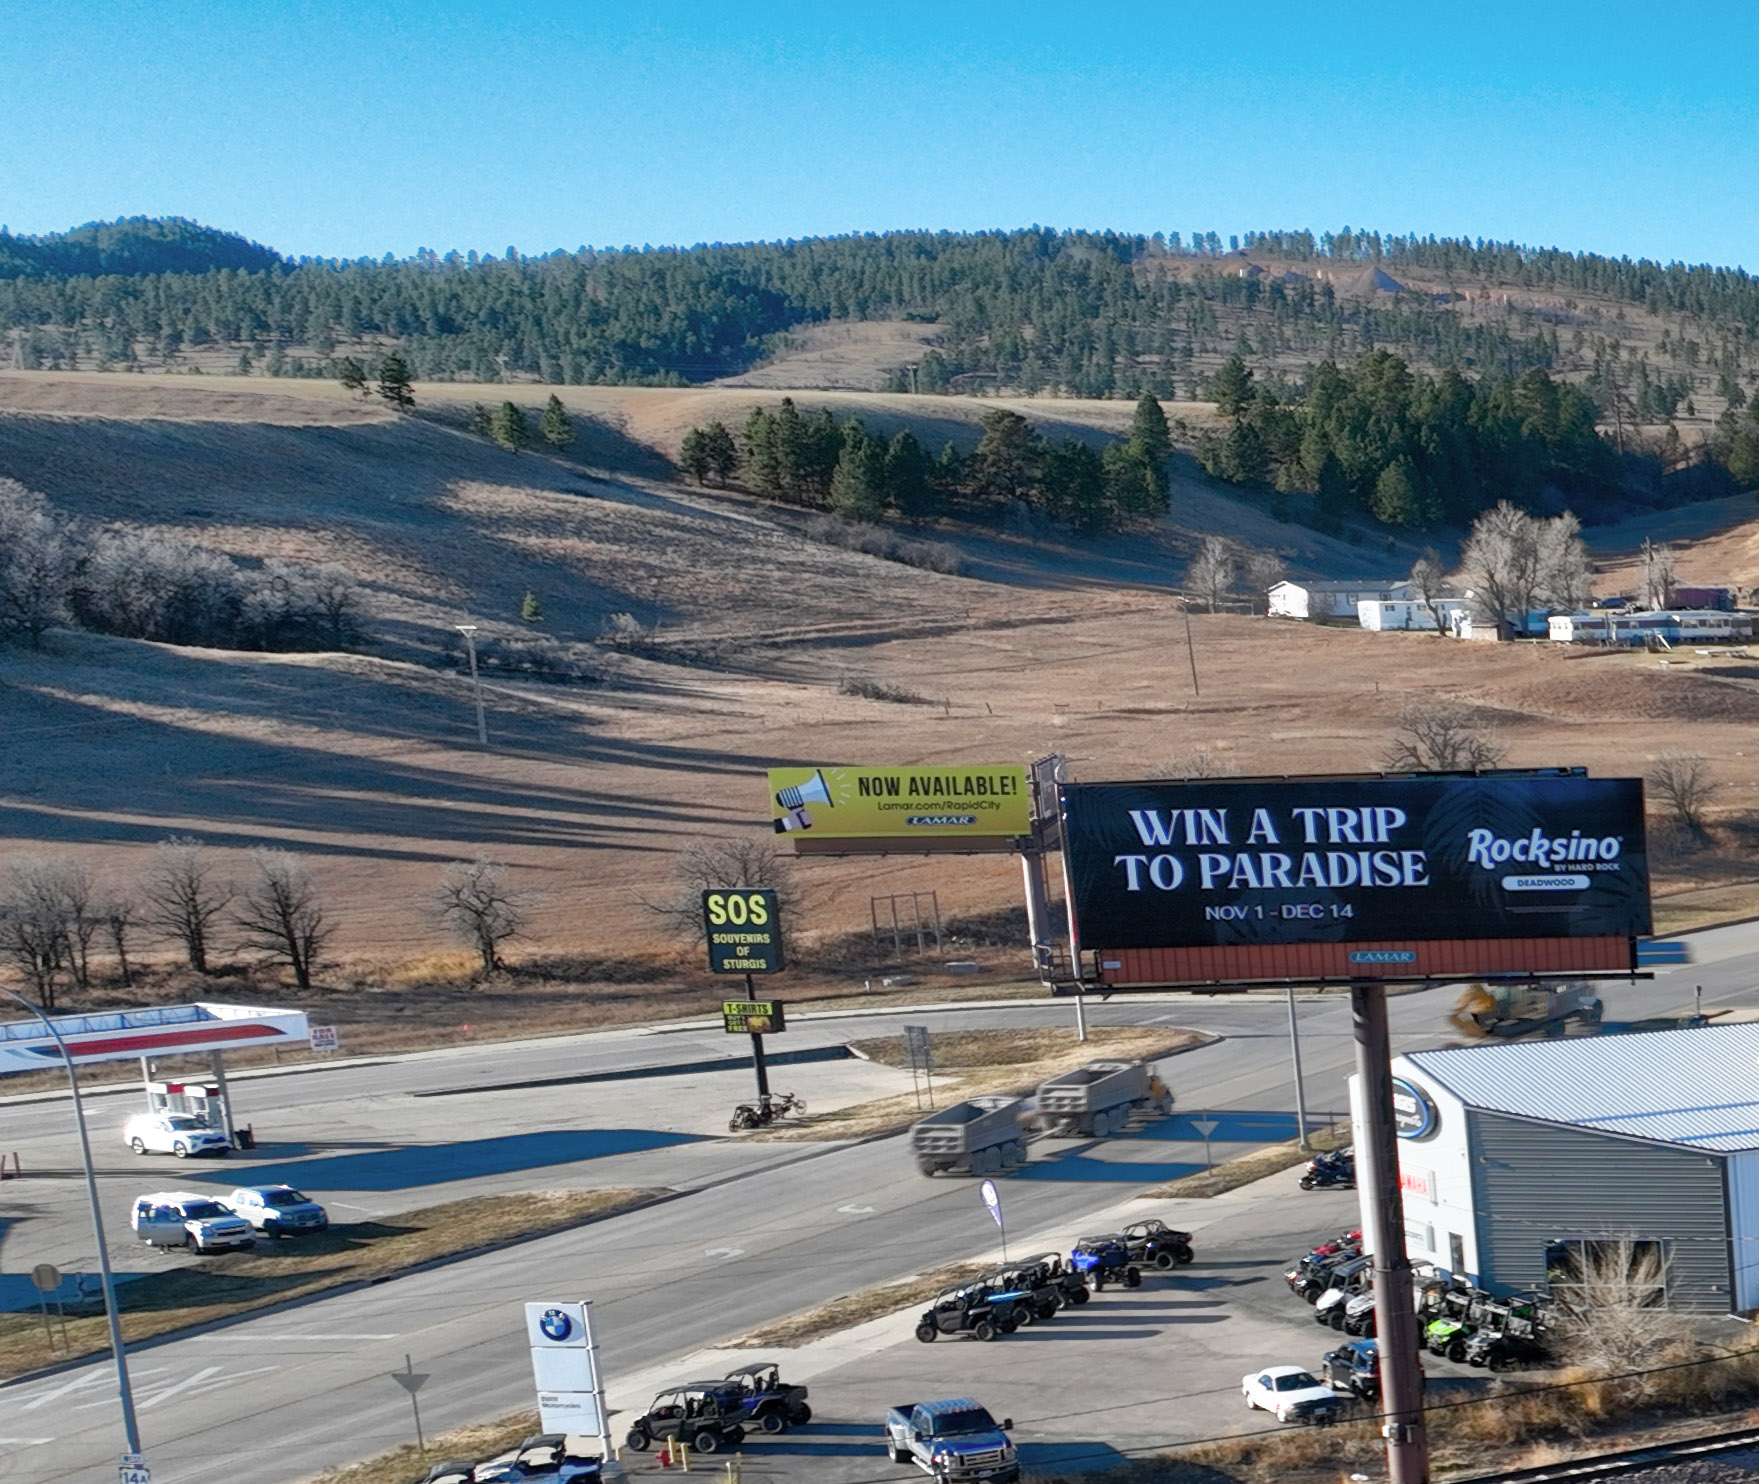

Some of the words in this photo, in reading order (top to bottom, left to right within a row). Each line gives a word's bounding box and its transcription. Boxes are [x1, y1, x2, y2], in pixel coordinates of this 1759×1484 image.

[858, 777, 901, 797] NOW
[908, 776, 1018, 797] AVAILABLE!
[877, 801, 1001, 811] Lamar.com/RapidCity
[911, 815, 970, 825] LAMAR
[1128, 808, 1231, 846] WIN
[1245, 808, 1280, 844] A
[1291, 807, 1407, 843] TRIP
[1467, 827, 1621, 870] Rocksino
[1113, 854, 1184, 891] TO
[1198, 851, 1430, 889] PARADISE
[1554, 864, 1566, 872] BY
[1595, 863, 1620, 871] ROCK
[1517, 878, 1575, 887] DEADWOOD
[708, 894, 768, 925] SOS
[1205, 905, 1248, 920] NOV
[1253, 904, 1263, 919] 1
[1281, 904, 1324, 919] DEC
[1331, 904, 1354, 918] 14
[712, 933, 771, 943] SOUVENIRS
[736, 946, 750, 956] OF
[1355, 952, 1411, 961] LAMAR
[723, 959, 767, 969] STURGIS
[726, 1004, 769, 1014] T-SHIRTS
[123, 1472, 148, 1484] 14A
